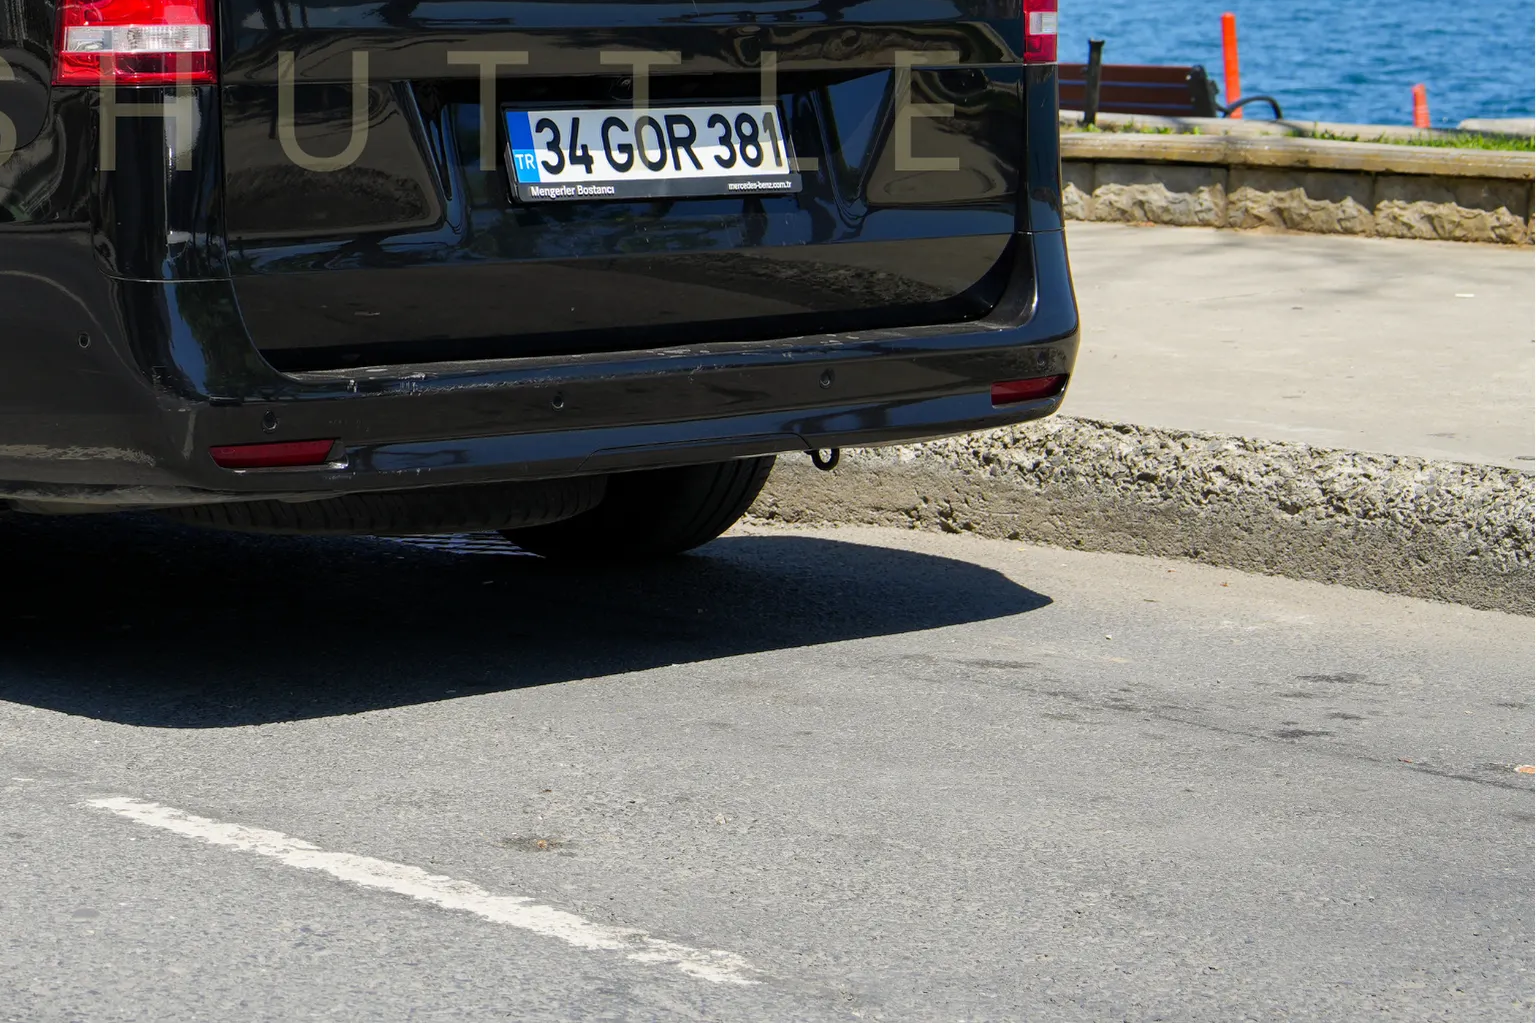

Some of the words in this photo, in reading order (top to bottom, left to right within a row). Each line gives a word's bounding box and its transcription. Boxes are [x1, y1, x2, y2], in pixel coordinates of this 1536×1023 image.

[535, 116, 594, 175] 34
[601, 113, 704, 173] GOR
[707, 111, 783, 169] 381
[514, 153, 536, 171] TR
[530, 185, 576, 199] Mengerler
[727, 180, 792, 191] mercedes-benz.com.tr
